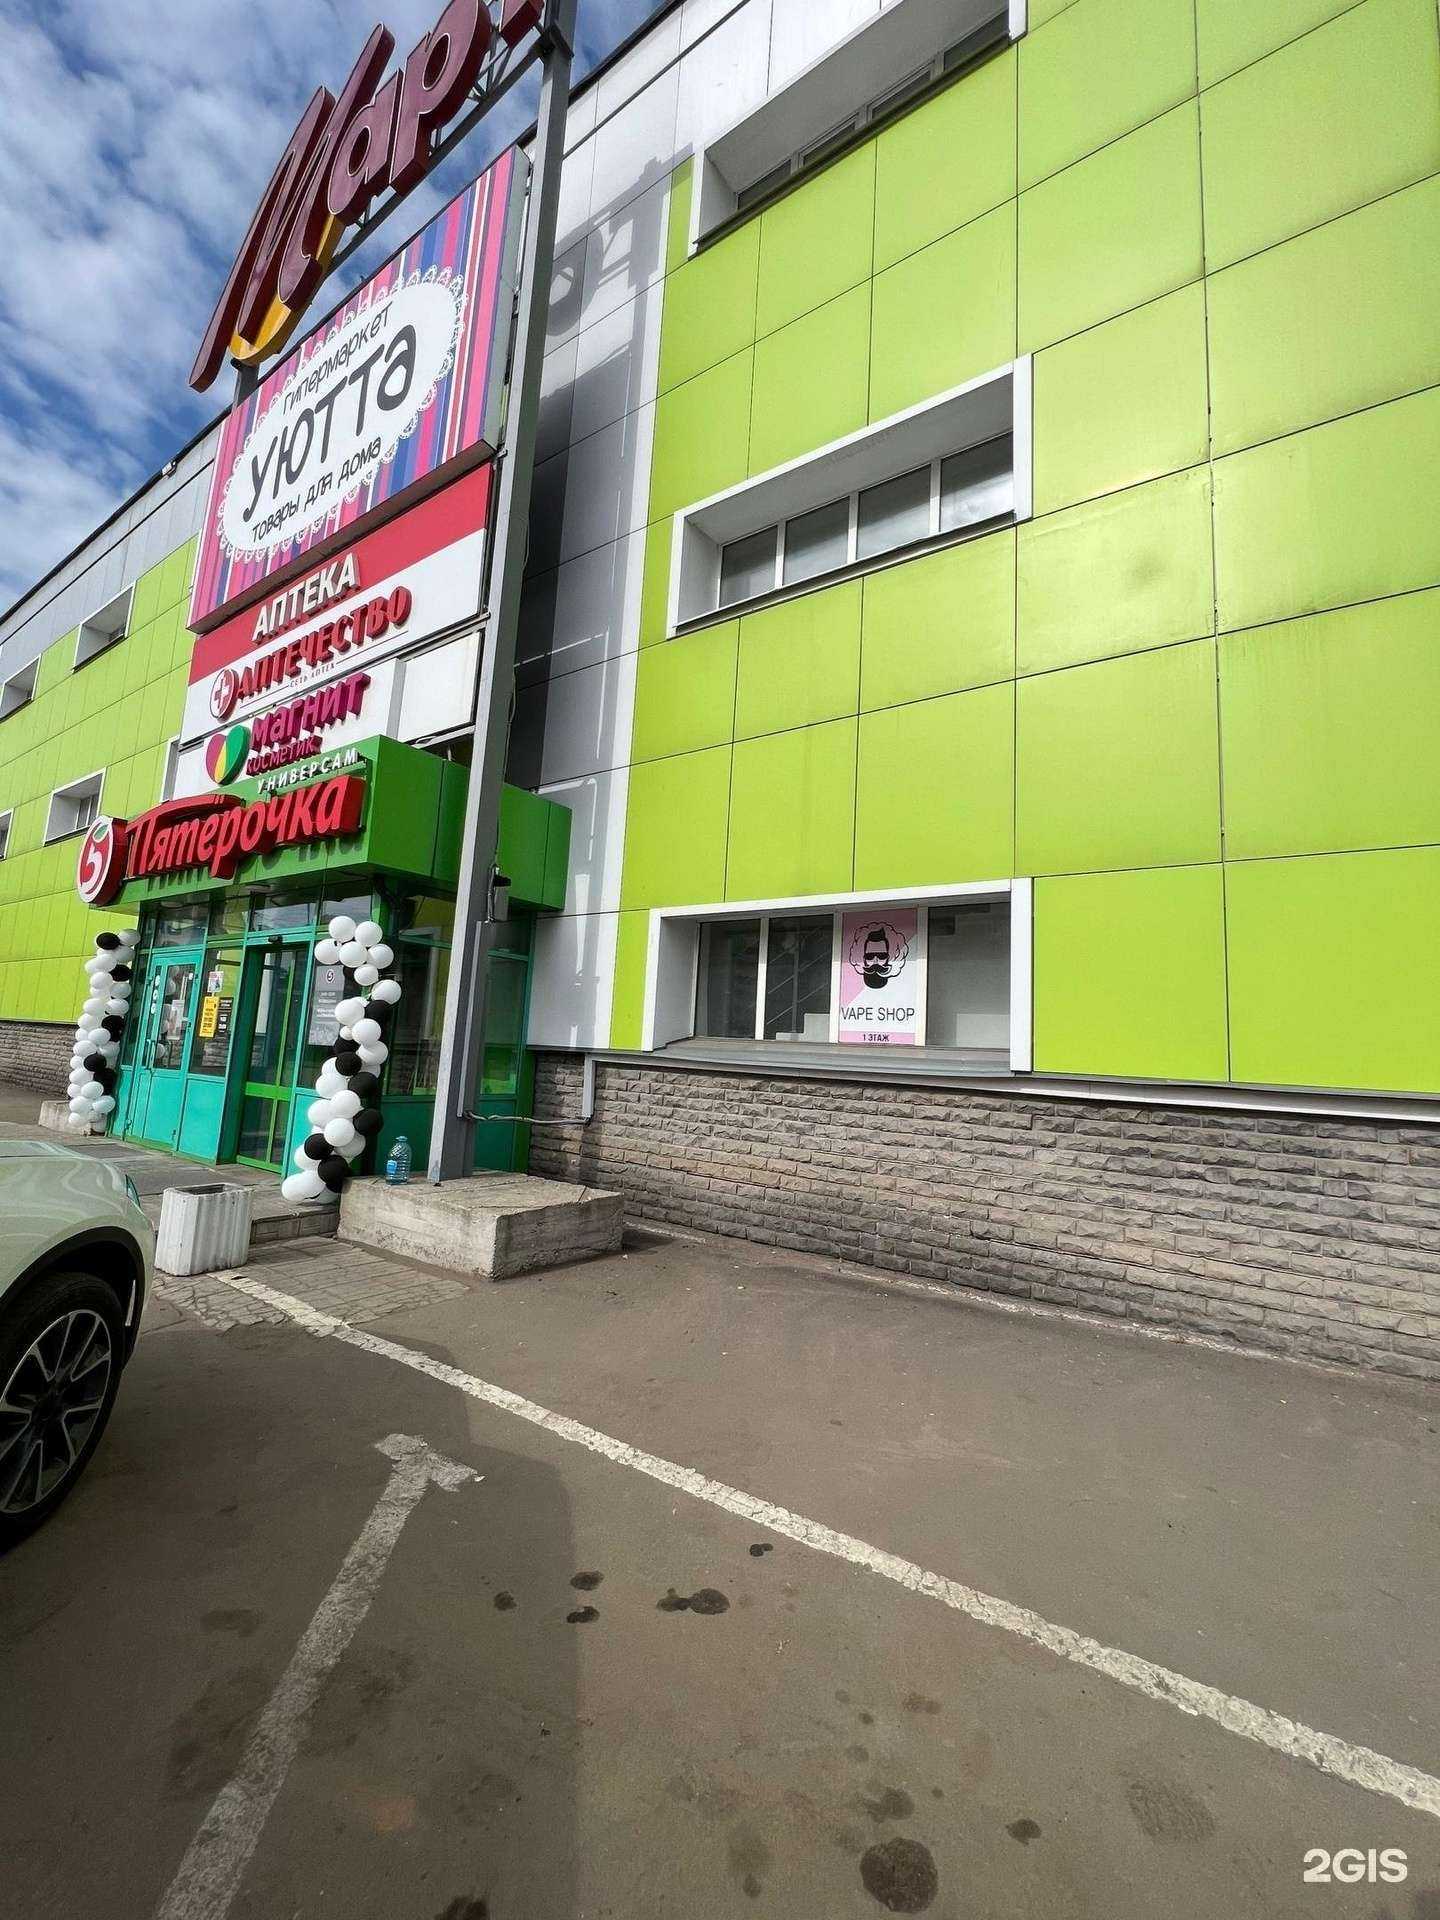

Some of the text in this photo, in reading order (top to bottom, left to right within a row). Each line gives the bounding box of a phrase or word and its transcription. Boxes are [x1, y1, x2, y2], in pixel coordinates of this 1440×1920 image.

[189, 0, 546, 393] Мар
[304, 472, 333, 513] для
[337, 436, 381, 489] дома
[252, 552, 361, 644] АПТЕКА
[237, 585, 412, 701] АПТЕЧЕСТВО
[258, 748, 359, 794] УНИВЕРСАМ
[841, 1007, 915, 1021] VAPE SHOP
[868, 1033, 889, 1042] ЭТАЖ
